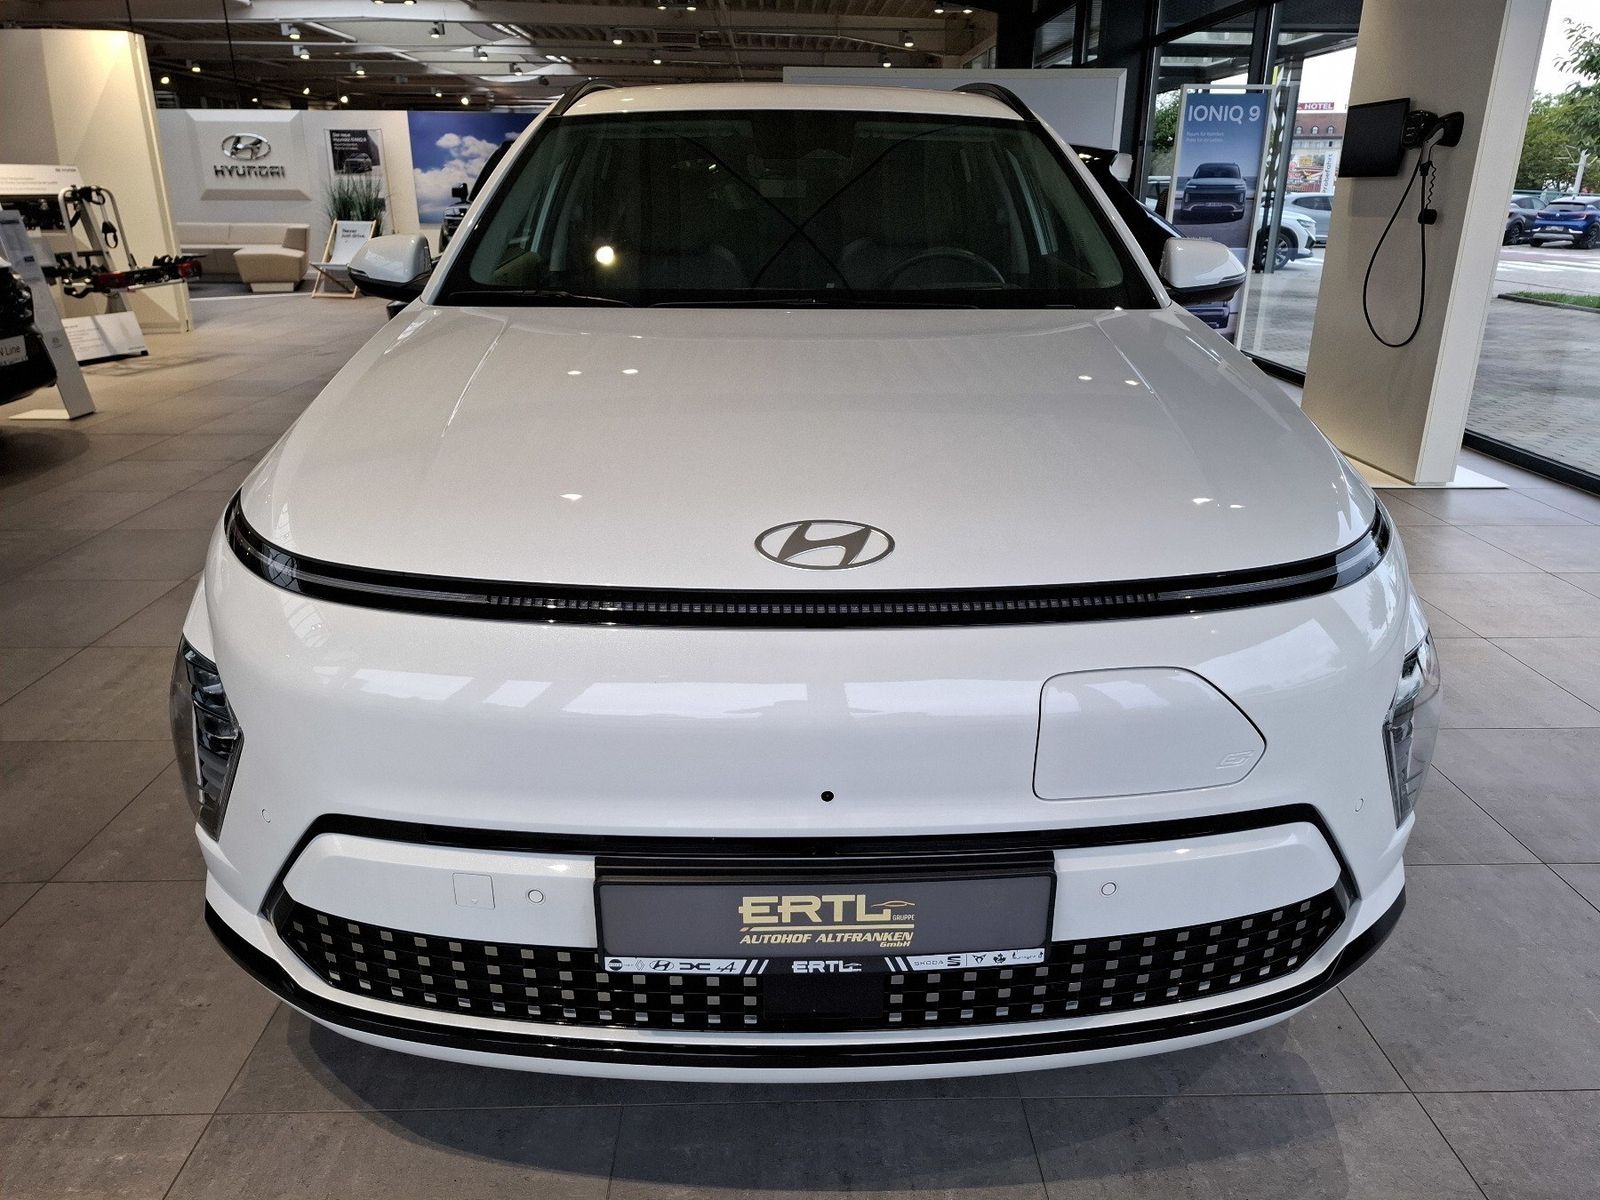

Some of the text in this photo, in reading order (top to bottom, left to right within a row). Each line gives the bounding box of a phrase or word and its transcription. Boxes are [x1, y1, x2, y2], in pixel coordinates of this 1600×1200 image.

[1304, 102, 1333, 110] HOTEL
[1188, 105, 1261, 125] IONIQ 9
[213, 165, 286, 178] HYUNDAI
[738, 894, 892, 924] ERTL
[739, 931, 914, 945] AUTOHOF ALTFRANKEN
[879, 940, 912, 948] GmbH
[791, 960, 862, 974] ERTL
